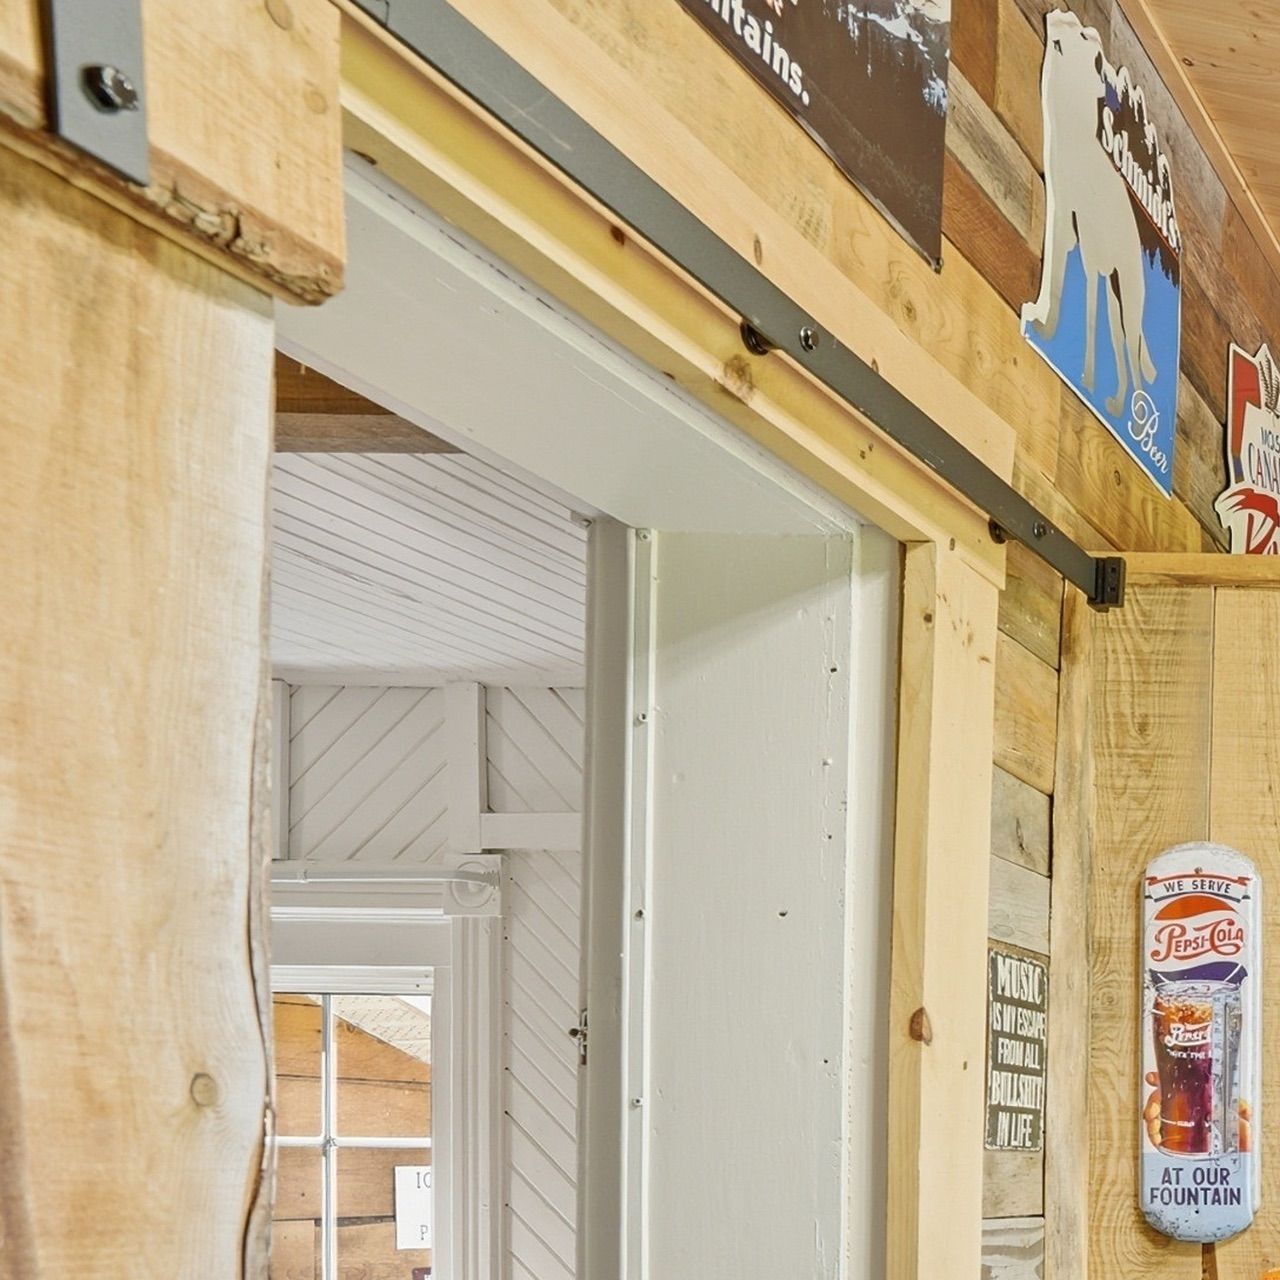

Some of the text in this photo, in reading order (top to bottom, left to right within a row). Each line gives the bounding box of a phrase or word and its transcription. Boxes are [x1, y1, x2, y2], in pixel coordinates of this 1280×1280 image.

[1102, 106, 1181, 253] Schmidt's
[1128, 390, 1168, 474] Beer
[1164, 877, 1232, 895] WE SERVE
[997, 954, 1042, 1005] MUSIC
[992, 1001, 1046, 1041] IS MY ESCAPE
[998, 1037, 1041, 1070] FROM ALL
[992, 1069, 1043, 1110] BULLSHIT
[997, 1111, 1033, 1147] IN LIFE
[1161, 1166, 1231, 1186] AT OUR
[1150, 1186, 1242, 1206] FOUNTAIN
